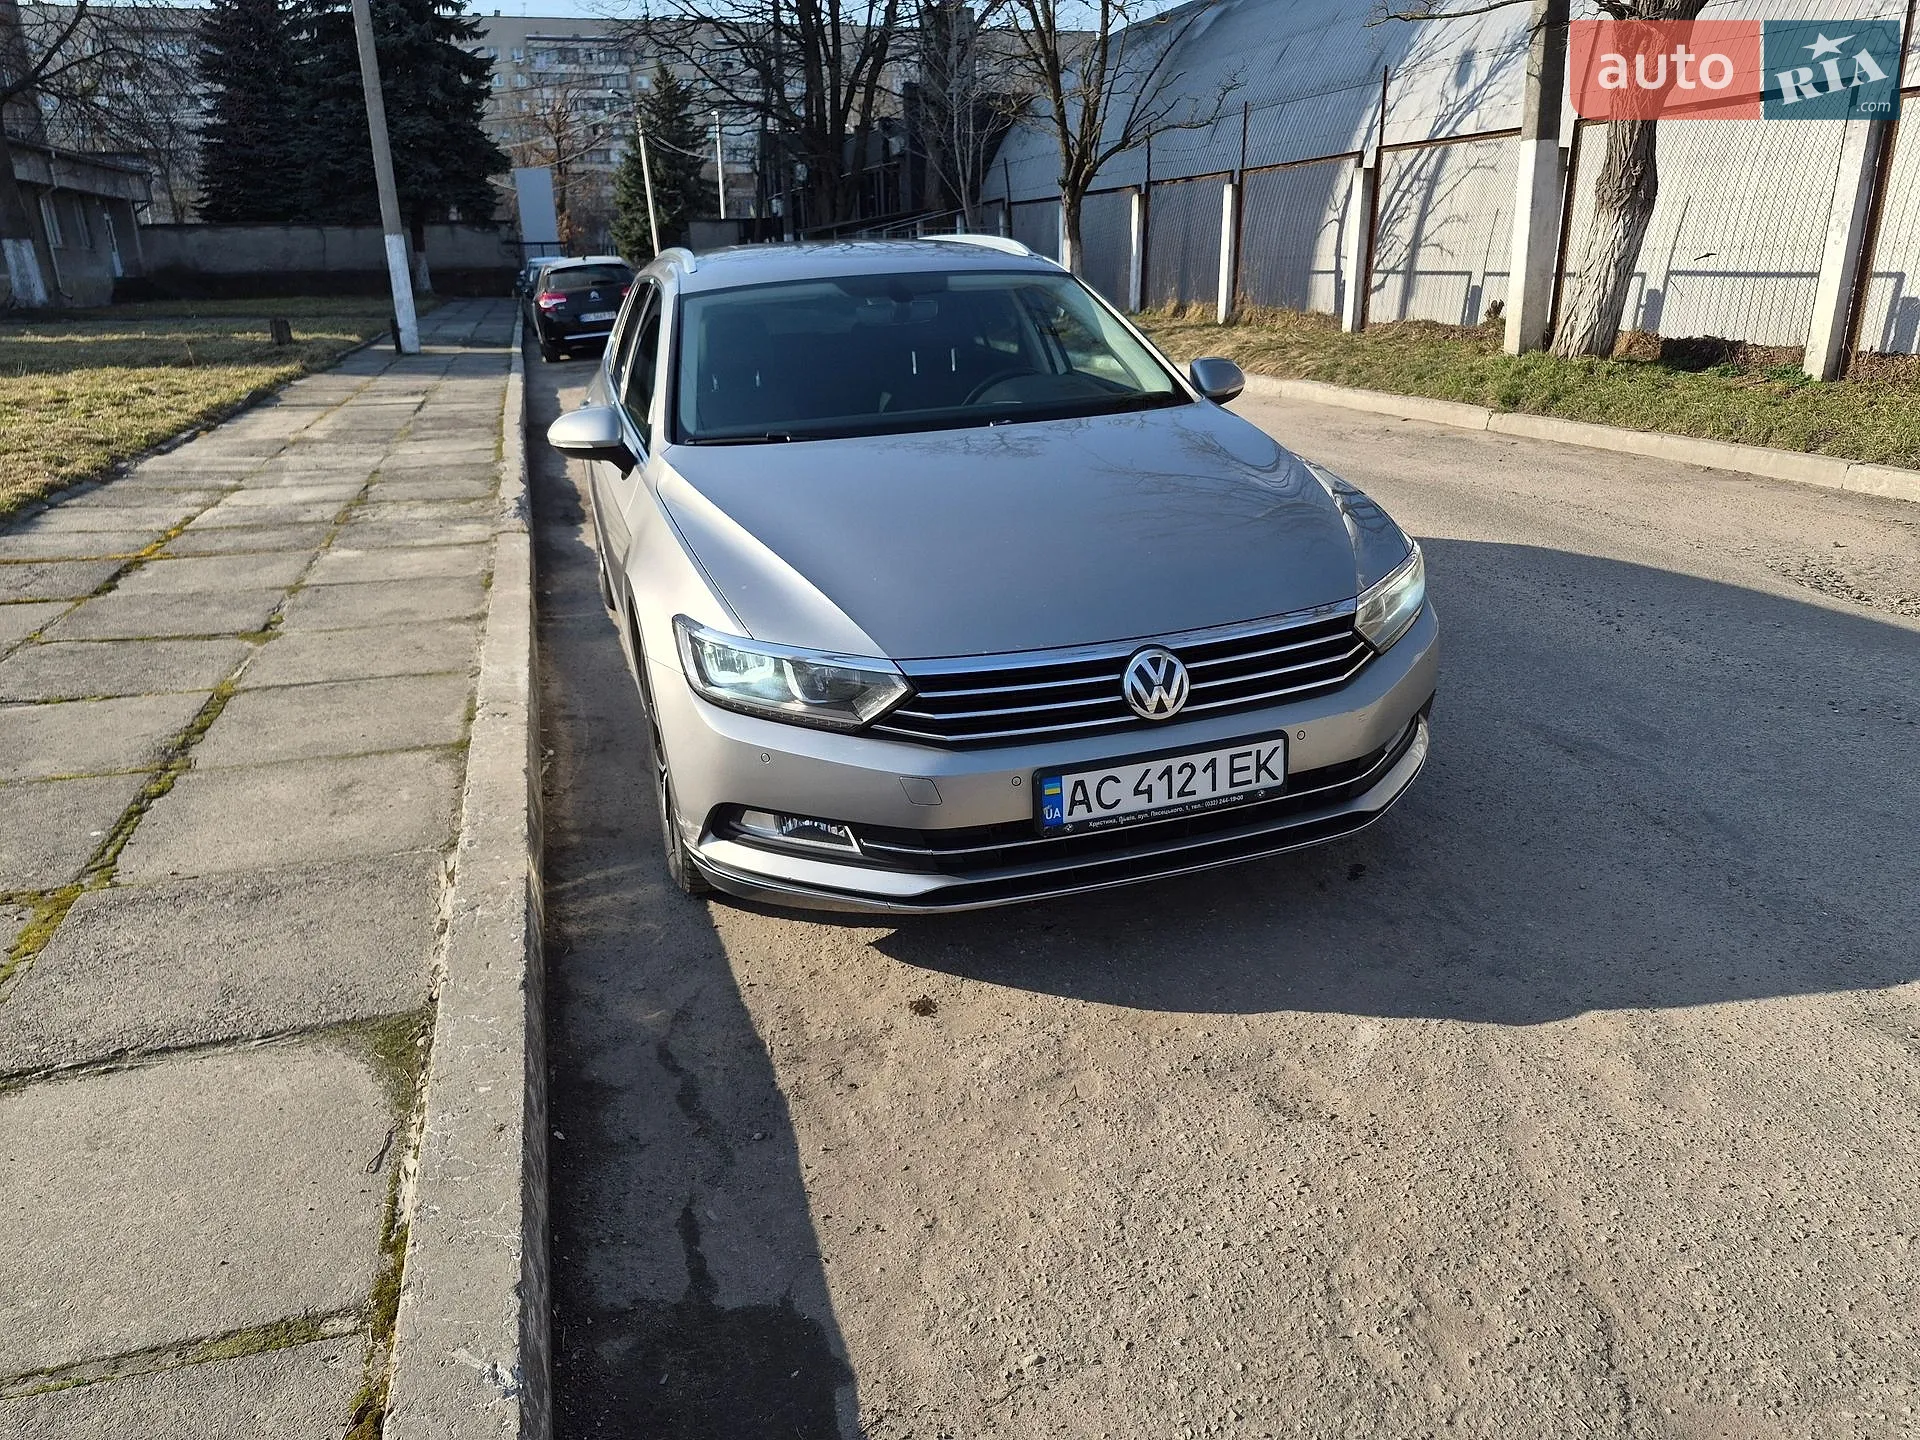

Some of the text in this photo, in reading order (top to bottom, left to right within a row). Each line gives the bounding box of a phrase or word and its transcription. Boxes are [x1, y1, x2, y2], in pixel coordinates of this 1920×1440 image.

[1067, 746, 1281, 817] AC 4121 EK
[1045, 808, 1061, 821] UA
